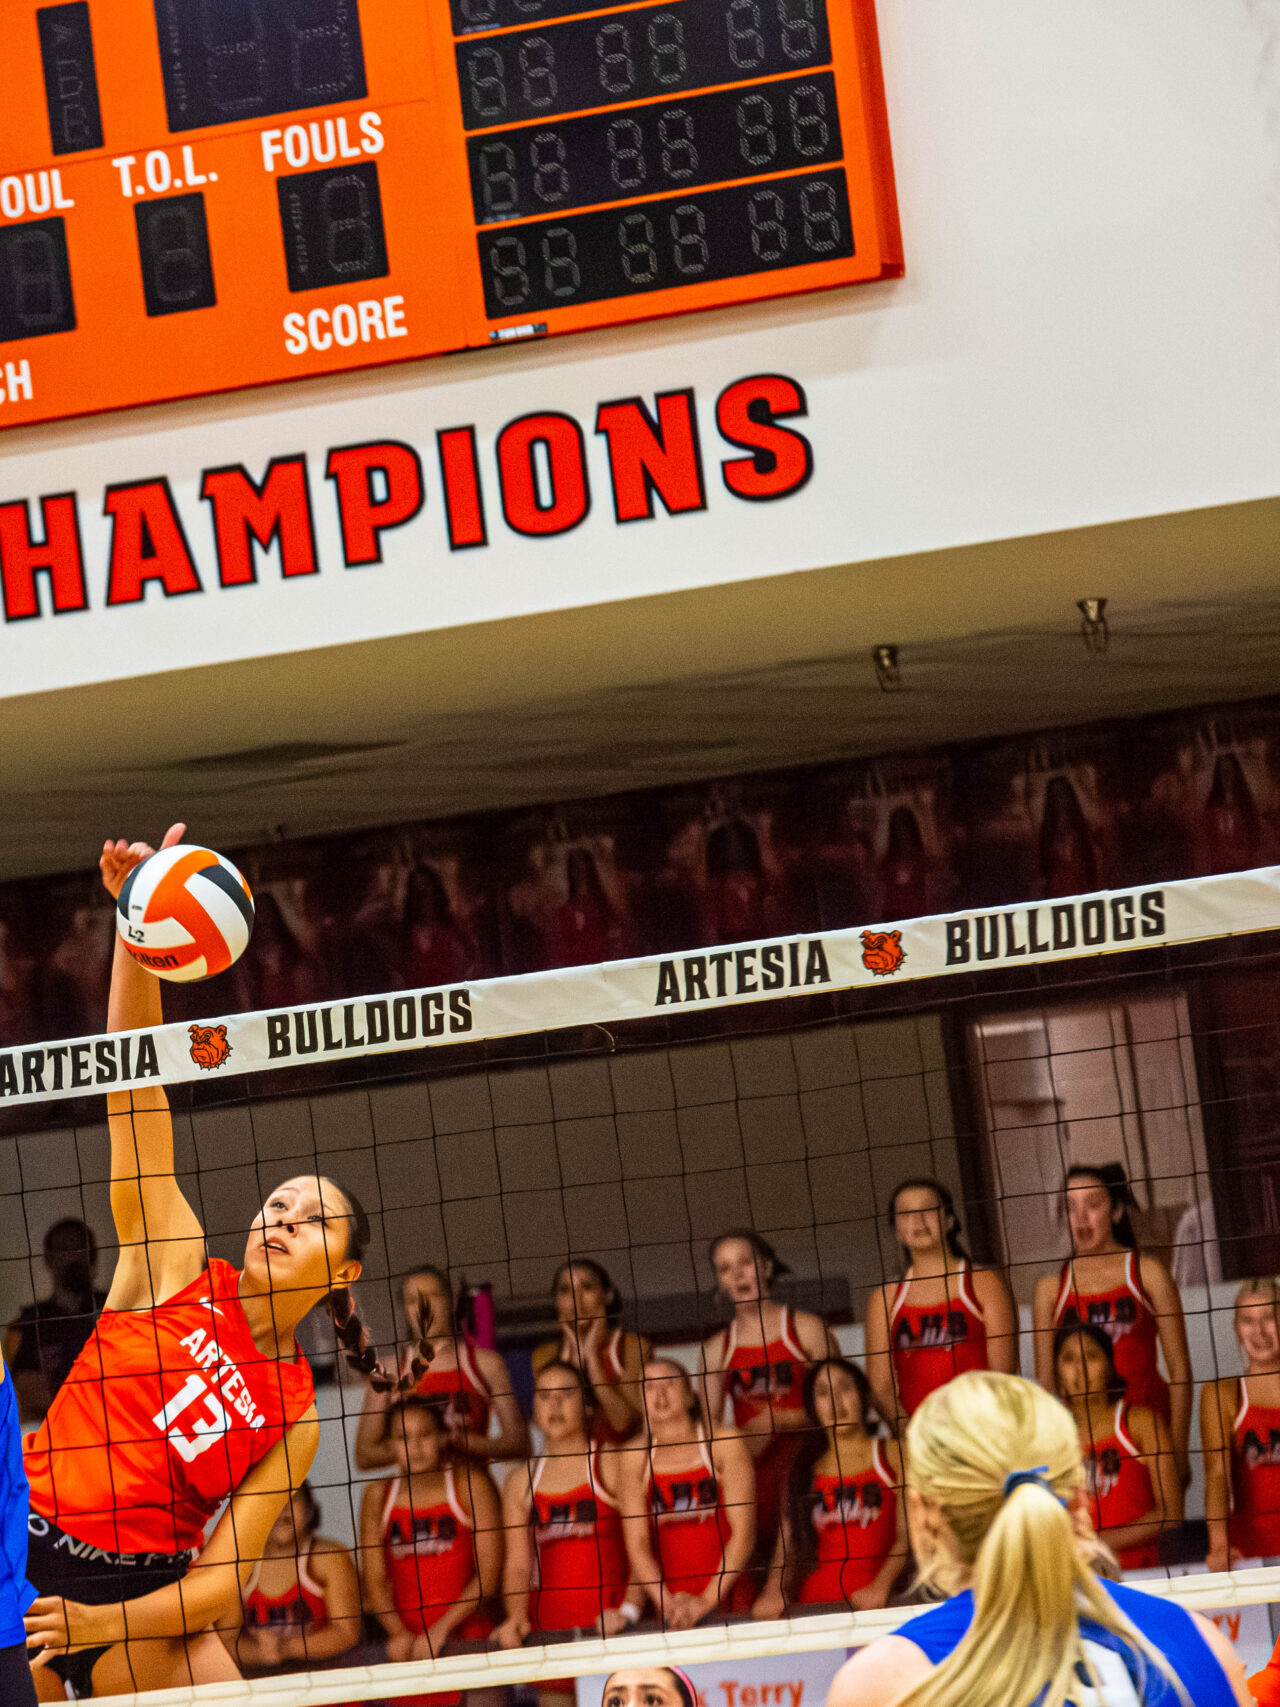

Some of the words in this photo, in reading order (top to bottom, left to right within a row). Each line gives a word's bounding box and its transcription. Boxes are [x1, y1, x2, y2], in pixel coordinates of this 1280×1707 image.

[111, 145, 219, 197] T.O.L.
[260, 111, 385, 172] FOULS
[283, 294, 408, 355] SCORE
[654, 940, 831, 1006] ARTESIA
[945, 890, 1166, 966] BULLDOGS
[267, 988, 473, 1059] BULLDOGS
[152, 1374, 232, 1463] 13
